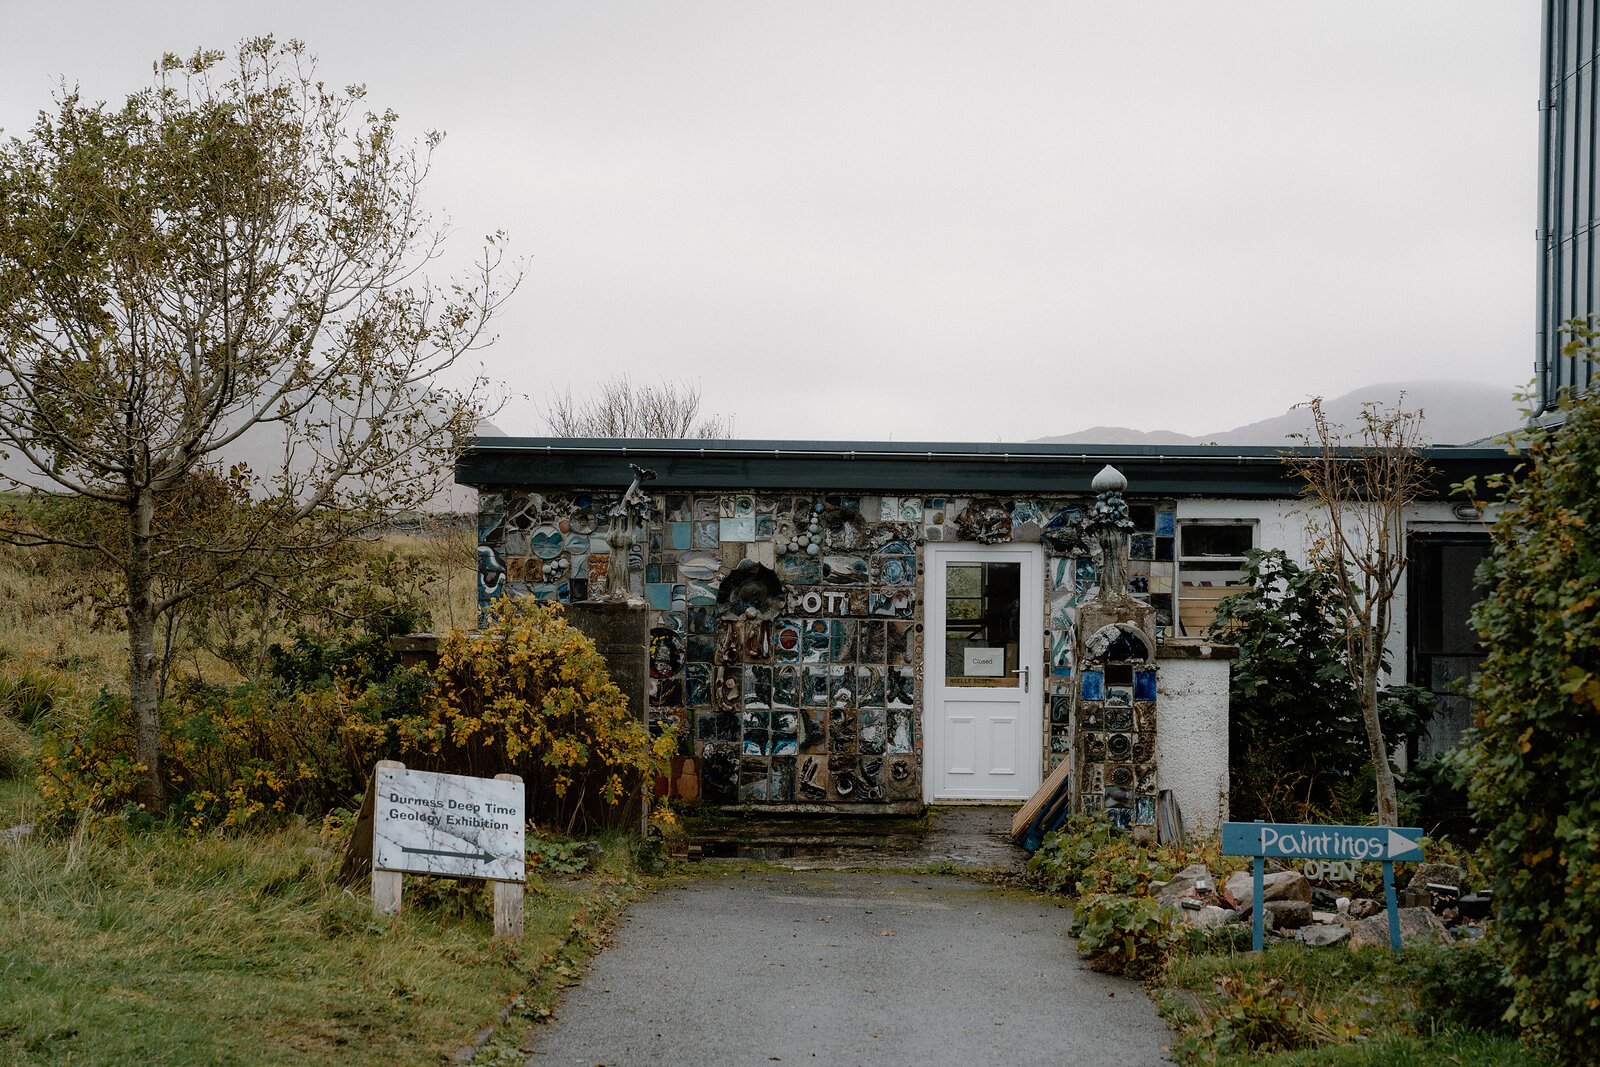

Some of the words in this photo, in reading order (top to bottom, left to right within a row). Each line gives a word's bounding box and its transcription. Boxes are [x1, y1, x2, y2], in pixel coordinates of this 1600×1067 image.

[972, 657, 993, 665] Closed
[389, 793, 444, 808] Durness
[448, 799, 481, 814] Deep
[485, 803, 516, 816] Time
[389, 808, 442, 825] Geology
[446, 815, 509, 830] Exhibition
[1261, 827, 1384, 859] Paintings
[1304, 860, 1355, 882] OPEN
